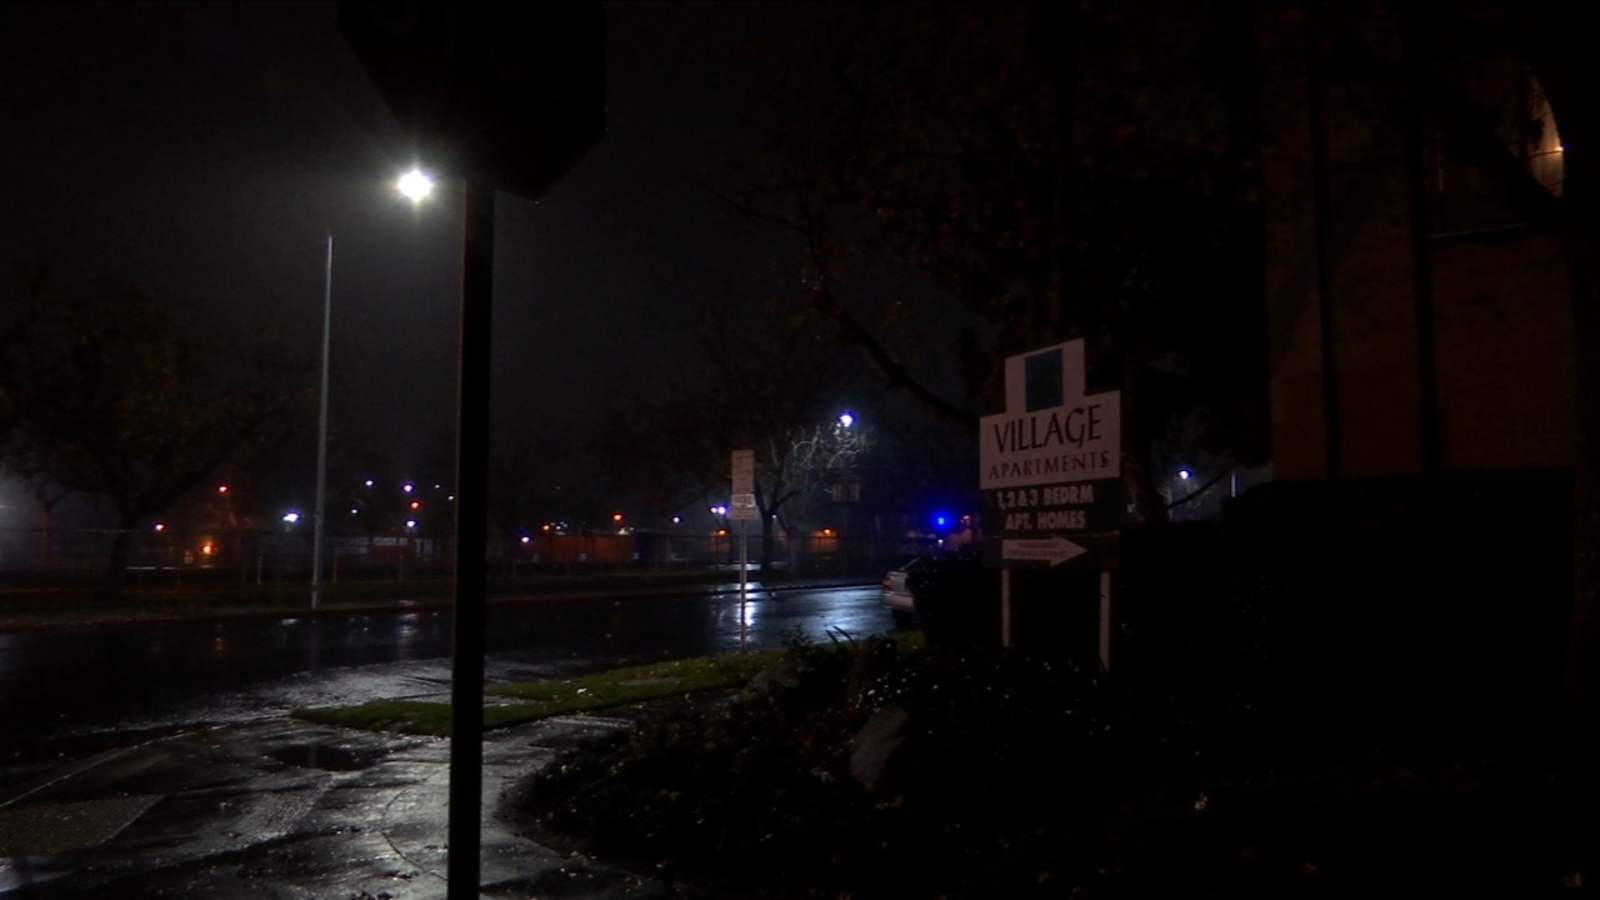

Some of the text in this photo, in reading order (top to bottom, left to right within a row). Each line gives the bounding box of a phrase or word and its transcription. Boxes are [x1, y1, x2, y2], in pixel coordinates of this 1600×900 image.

[994, 404, 1101, 453] VILLAGE
[989, 450, 1109, 480] APARTMENTS
[1043, 485, 1094, 506] BEDRM
[1005, 510, 1086, 531] APT. HOMES
